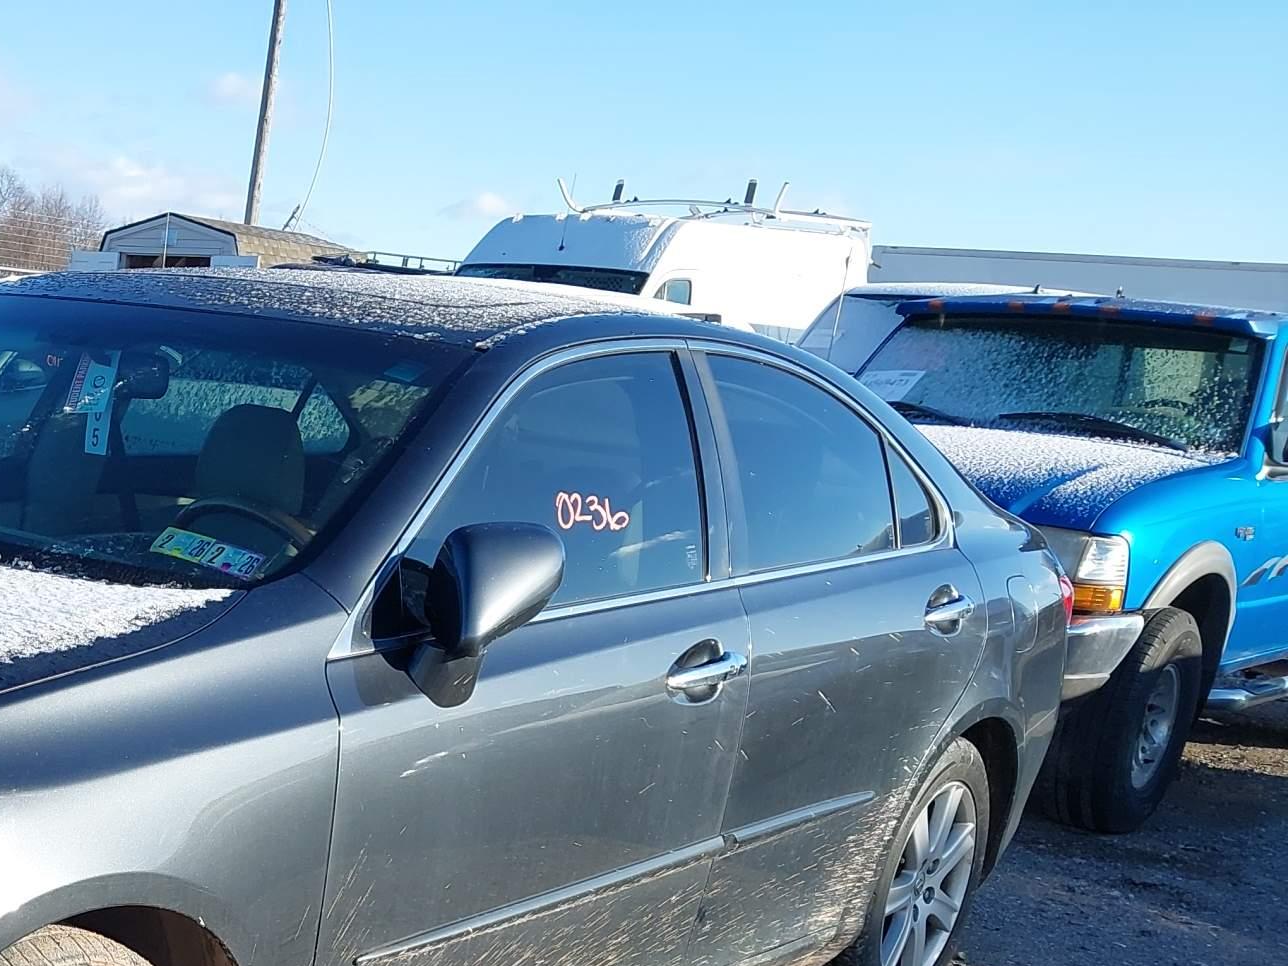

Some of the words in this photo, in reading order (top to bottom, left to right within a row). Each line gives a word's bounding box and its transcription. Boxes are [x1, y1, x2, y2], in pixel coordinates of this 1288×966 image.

[555, 491, 630, 531] 0236
[158, 534, 174, 549] 2
[188, 539, 211, 557] 26
[207, 546, 225, 565] 2
[238, 555, 261, 575] 26
